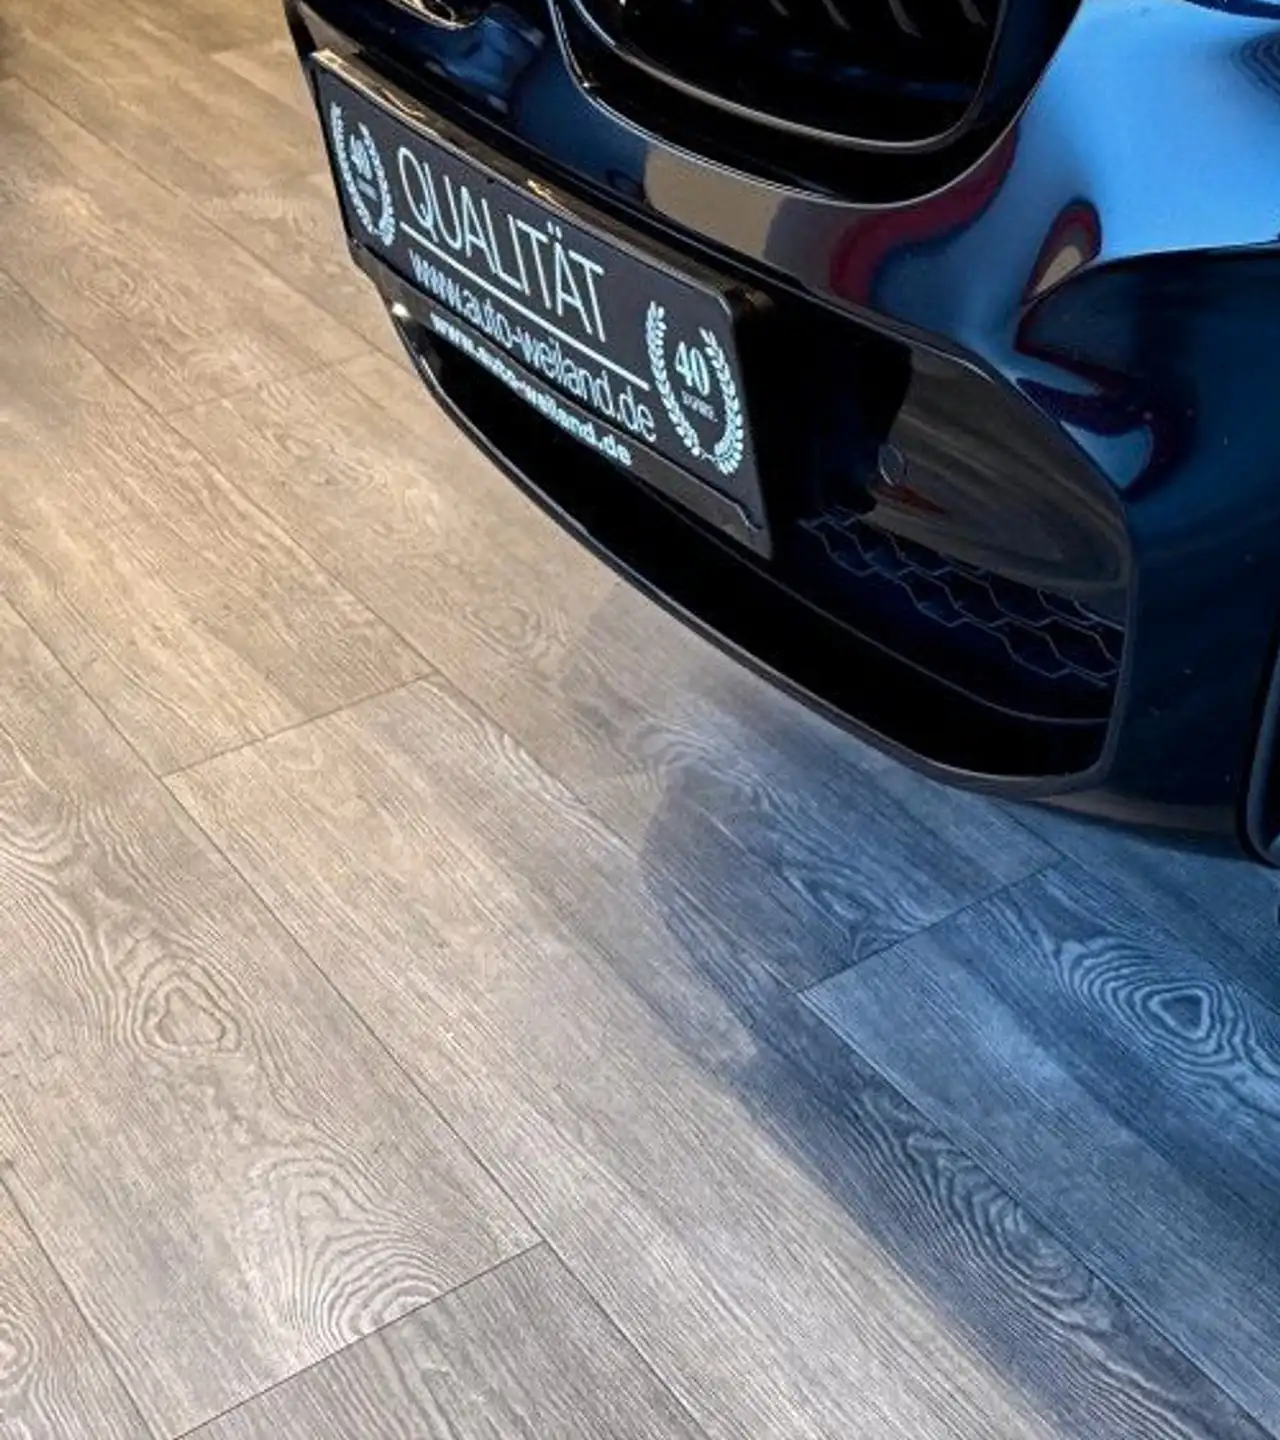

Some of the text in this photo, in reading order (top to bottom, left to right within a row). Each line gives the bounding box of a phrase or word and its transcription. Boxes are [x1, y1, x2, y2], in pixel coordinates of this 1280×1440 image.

[398, 145, 606, 343] QUALITÄT
[408, 247, 657, 444] www.auto-weiland.de
[675, 341, 710, 397] 40
